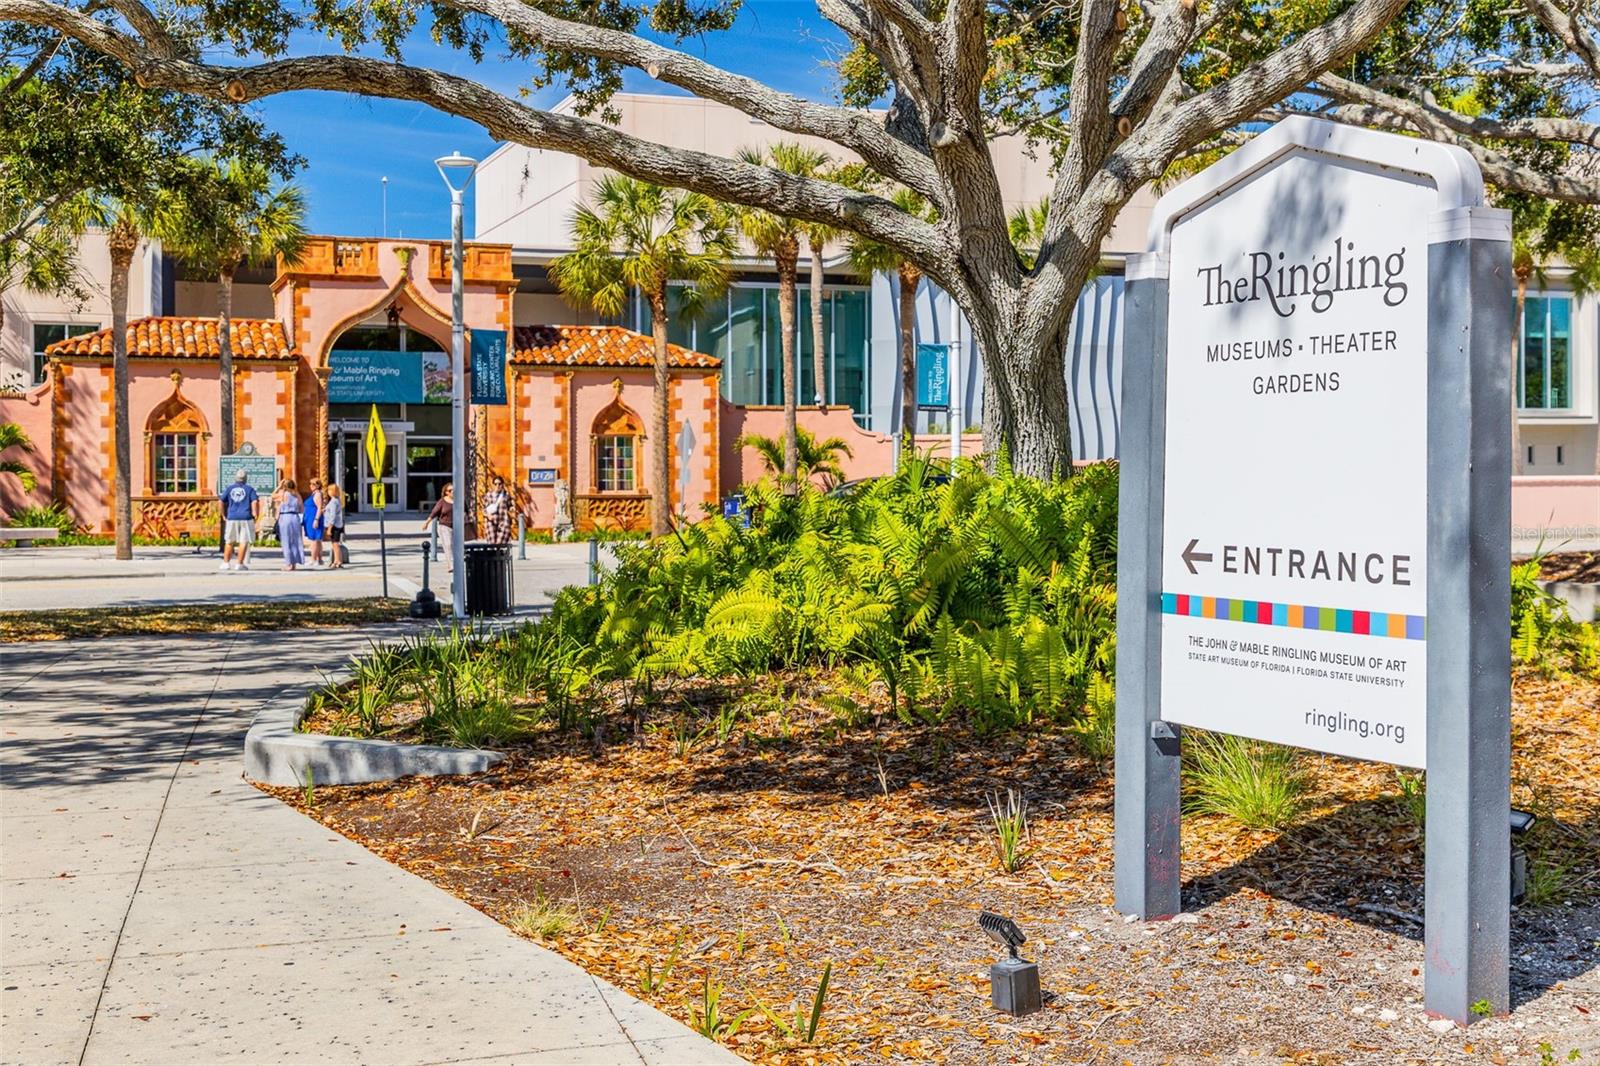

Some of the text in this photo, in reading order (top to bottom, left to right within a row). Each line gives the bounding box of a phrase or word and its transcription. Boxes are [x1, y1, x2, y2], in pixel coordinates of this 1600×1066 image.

[330, 356, 370, 364] WELCOME TO
[1206, 330, 1397, 363] MUSEUMS THEATER
[328, 374, 378, 382] useum of Art
[343, 366, 367, 374] Mable
[368, 366, 400, 376] Ringling
[1253, 371, 1340, 395] GARDENS
[1223, 545, 1411, 586] ENTRANCE
[1188, 635, 1407, 672] THE JOHN & MABLE RINGLING MUSEUM OF ART
[1188, 652, 1405, 688] STATE ART MUSEUM OF FLORIDA FLORIDA STATE UNIVERSITY
[1305, 708, 1405, 744] ringling.org
